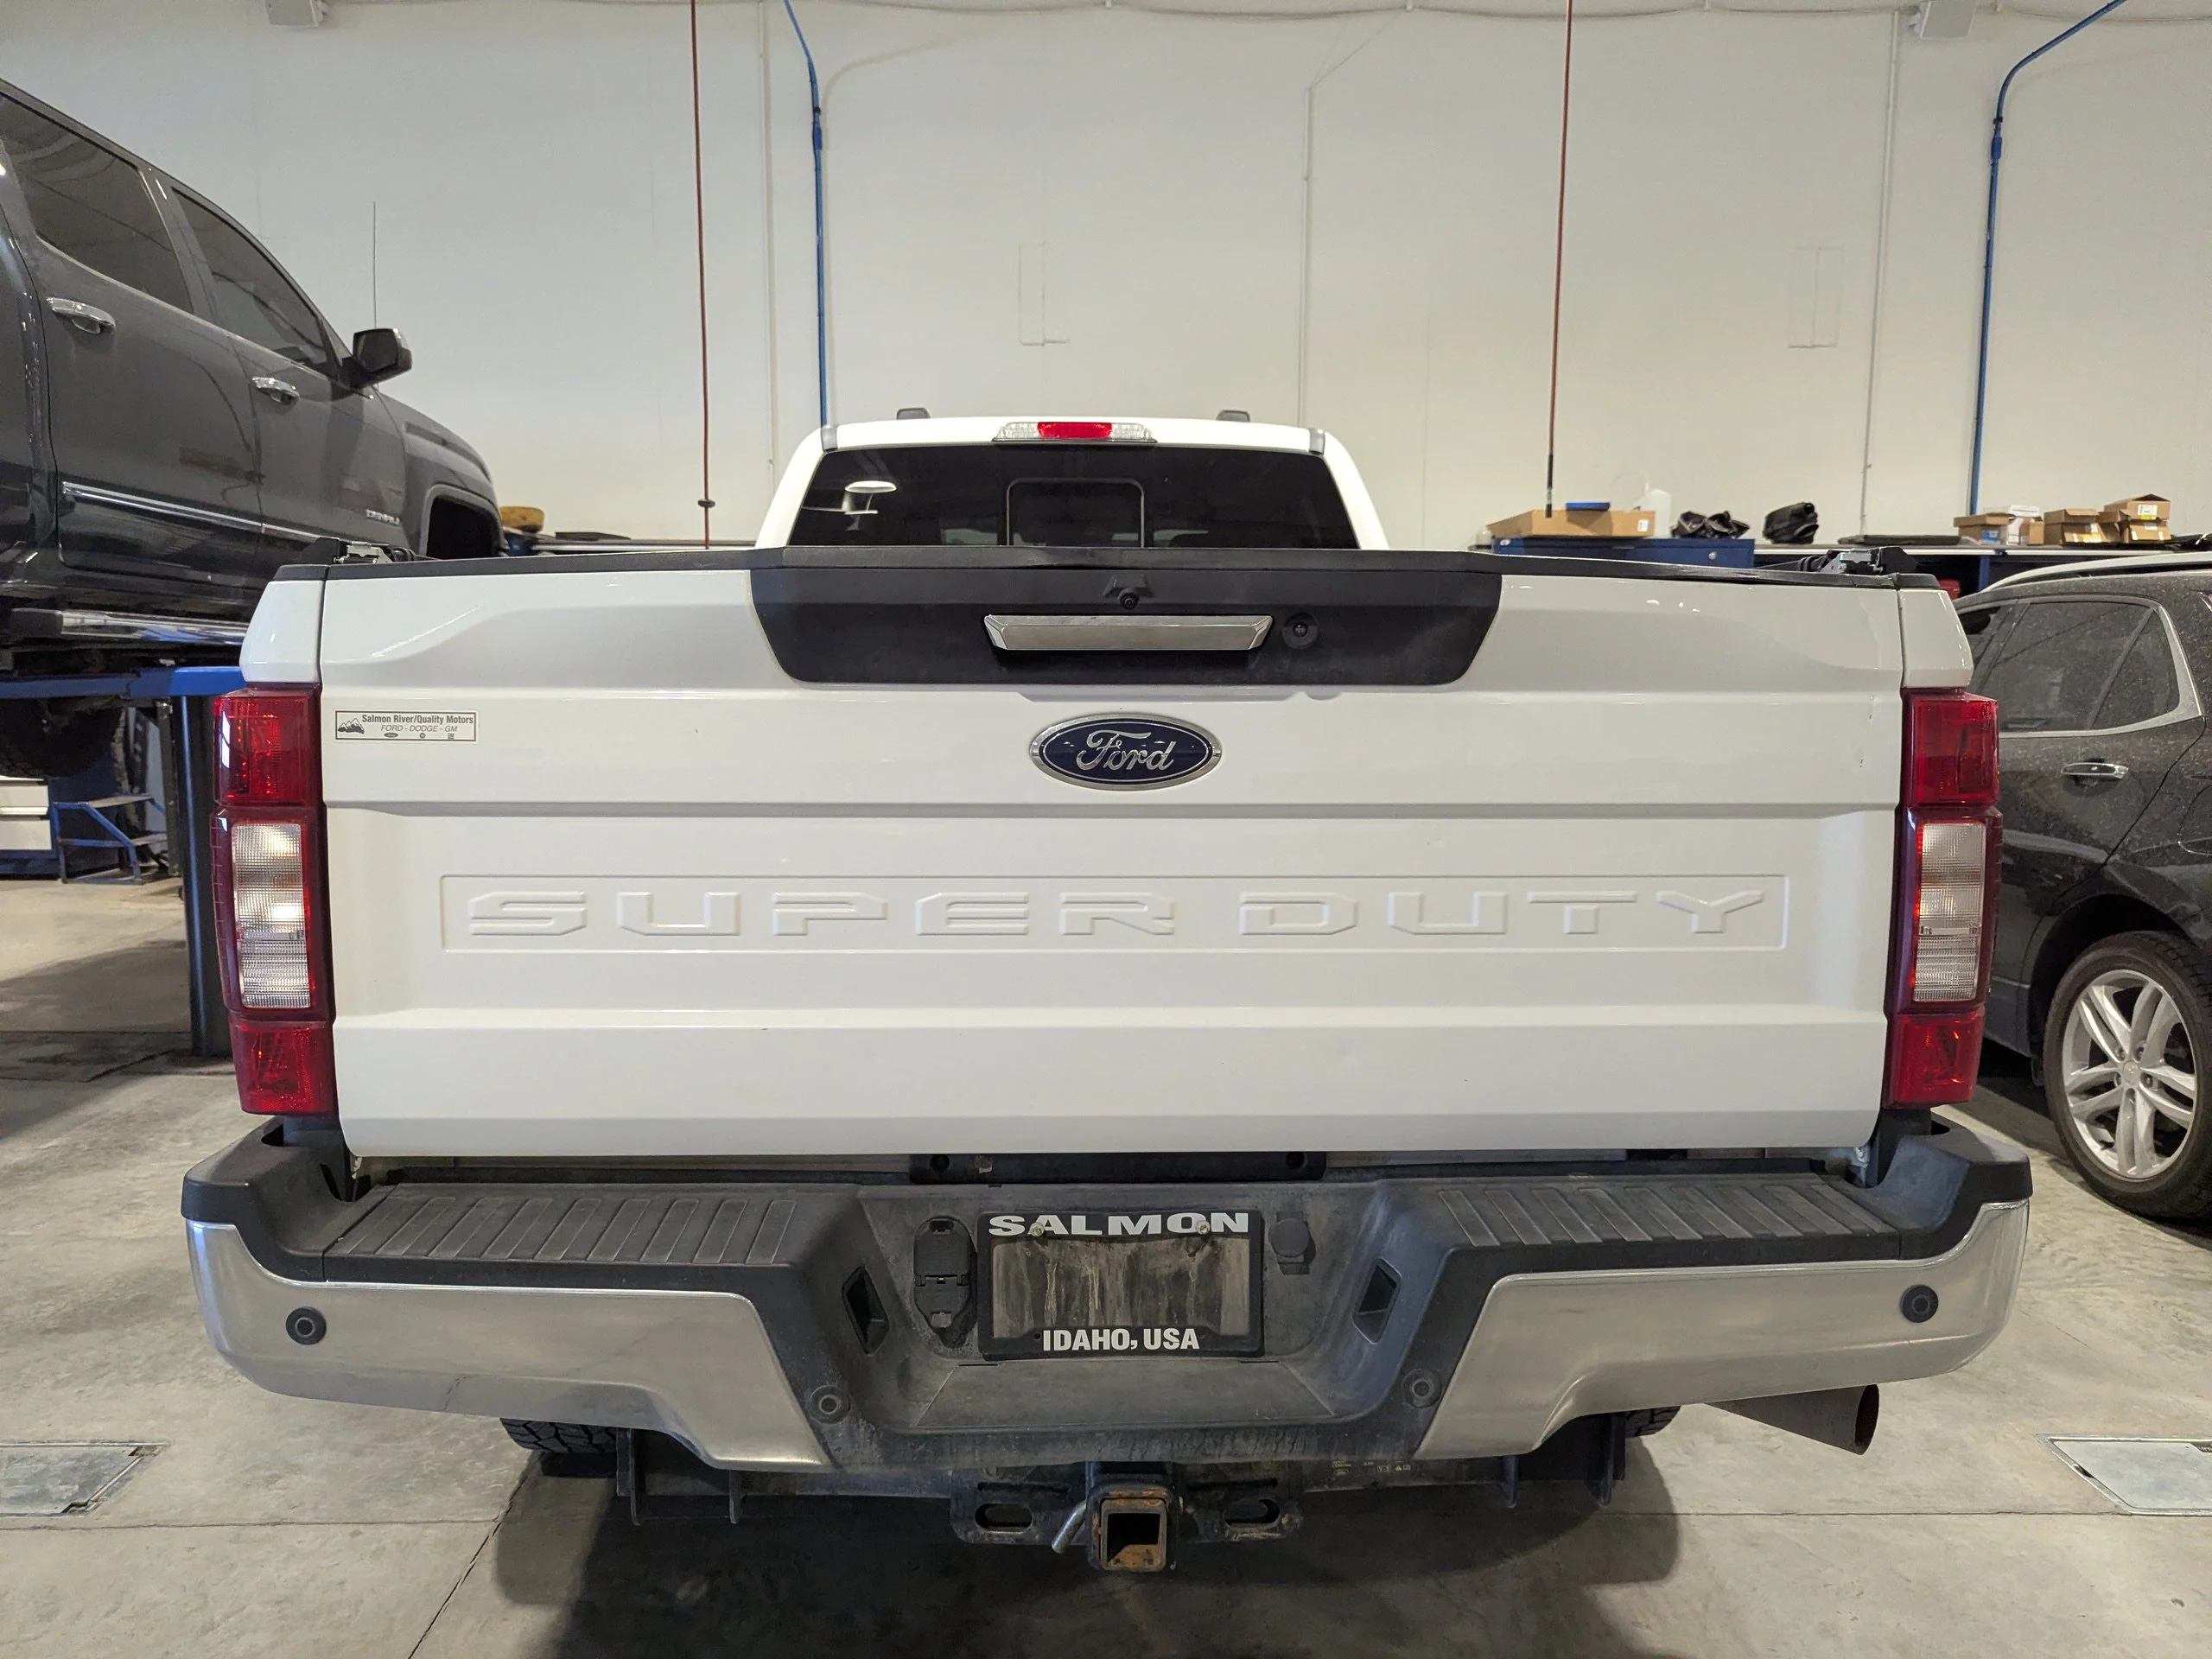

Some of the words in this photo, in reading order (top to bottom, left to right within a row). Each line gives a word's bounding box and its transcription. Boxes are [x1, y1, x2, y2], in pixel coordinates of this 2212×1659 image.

[362, 714, 391, 723] Salmon
[394, 715, 444, 725] River/Quality
[446, 715, 474, 724] Motors
[1076, 729, 1177, 771] Ford
[467, 891, 1175, 936] SUPER
[1239, 890, 1764, 936] DUTY
[988, 1211, 1249, 1236] SALMON
[1042, 1328, 1138, 1351] IDAHO,
[1142, 1327, 1200, 1350] USA
